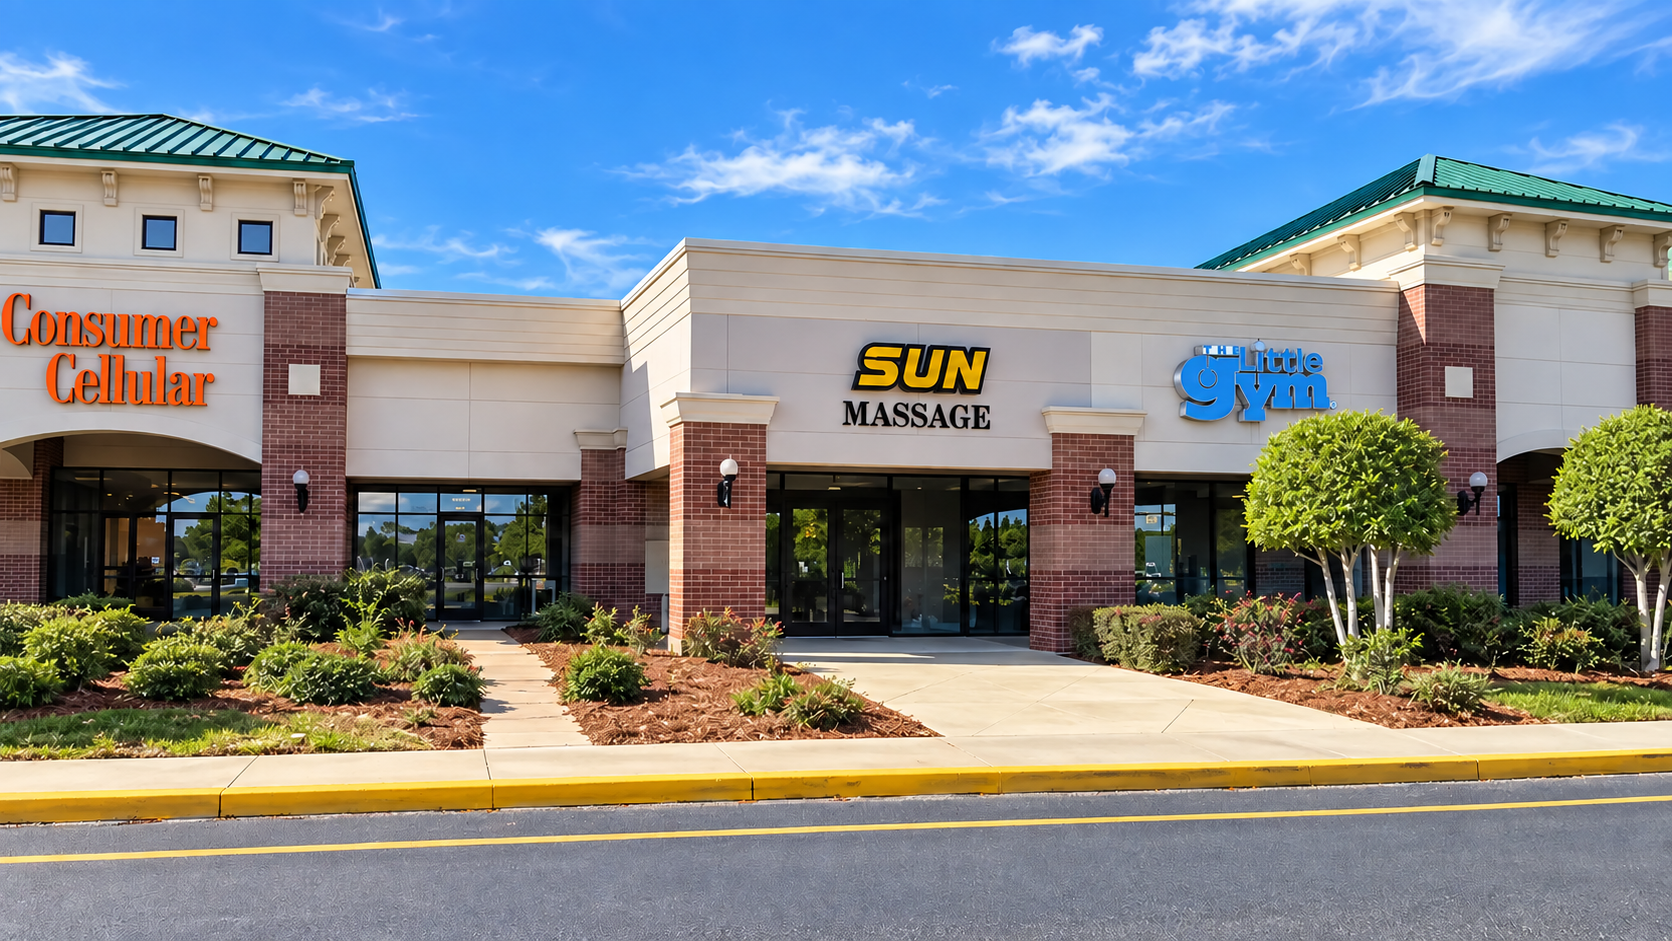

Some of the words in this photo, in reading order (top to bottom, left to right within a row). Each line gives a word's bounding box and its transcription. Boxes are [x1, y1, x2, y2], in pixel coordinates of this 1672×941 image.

[1, 292, 218, 350] Consumer
[46, 352, 215, 406] Cellular
[851, 342, 991, 395] SUN
[1203, 344, 1239, 355] THE
[1239, 341, 1324, 373] Little
[1174, 354, 1330, 422] gym
[842, 400, 991, 430] MASSAGE
